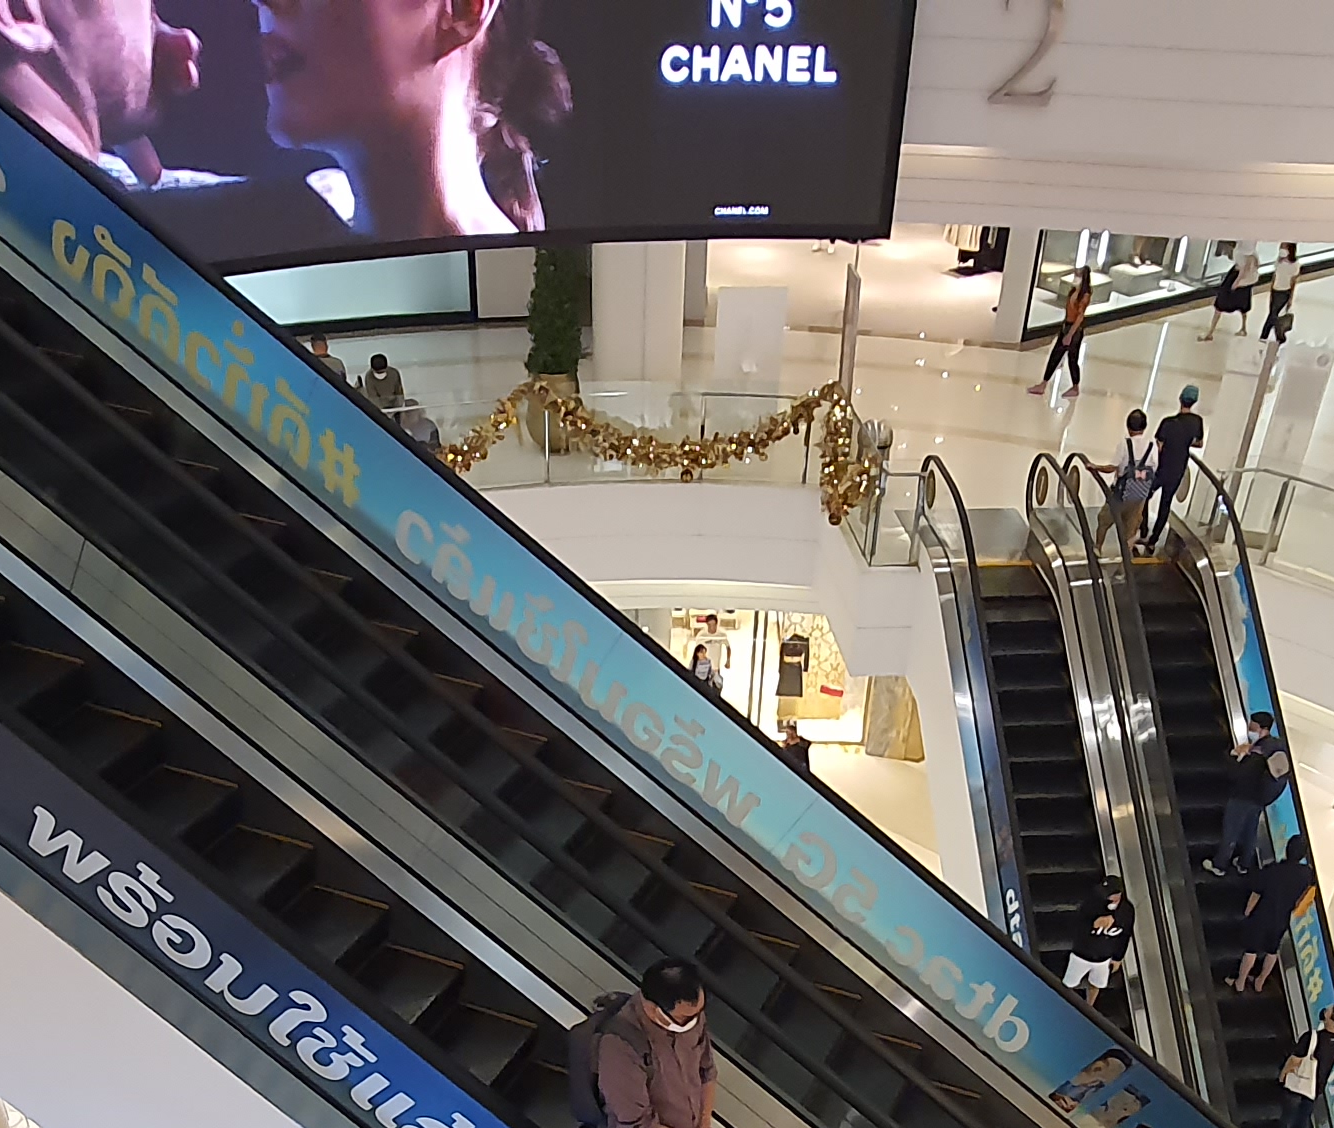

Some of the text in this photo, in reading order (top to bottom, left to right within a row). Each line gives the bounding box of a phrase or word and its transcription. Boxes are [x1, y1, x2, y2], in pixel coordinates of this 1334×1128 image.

[710, 0, 795, 28] N5
[660, 44, 837, 83] CHANEL
[987, 0, 1064, 107] 2
